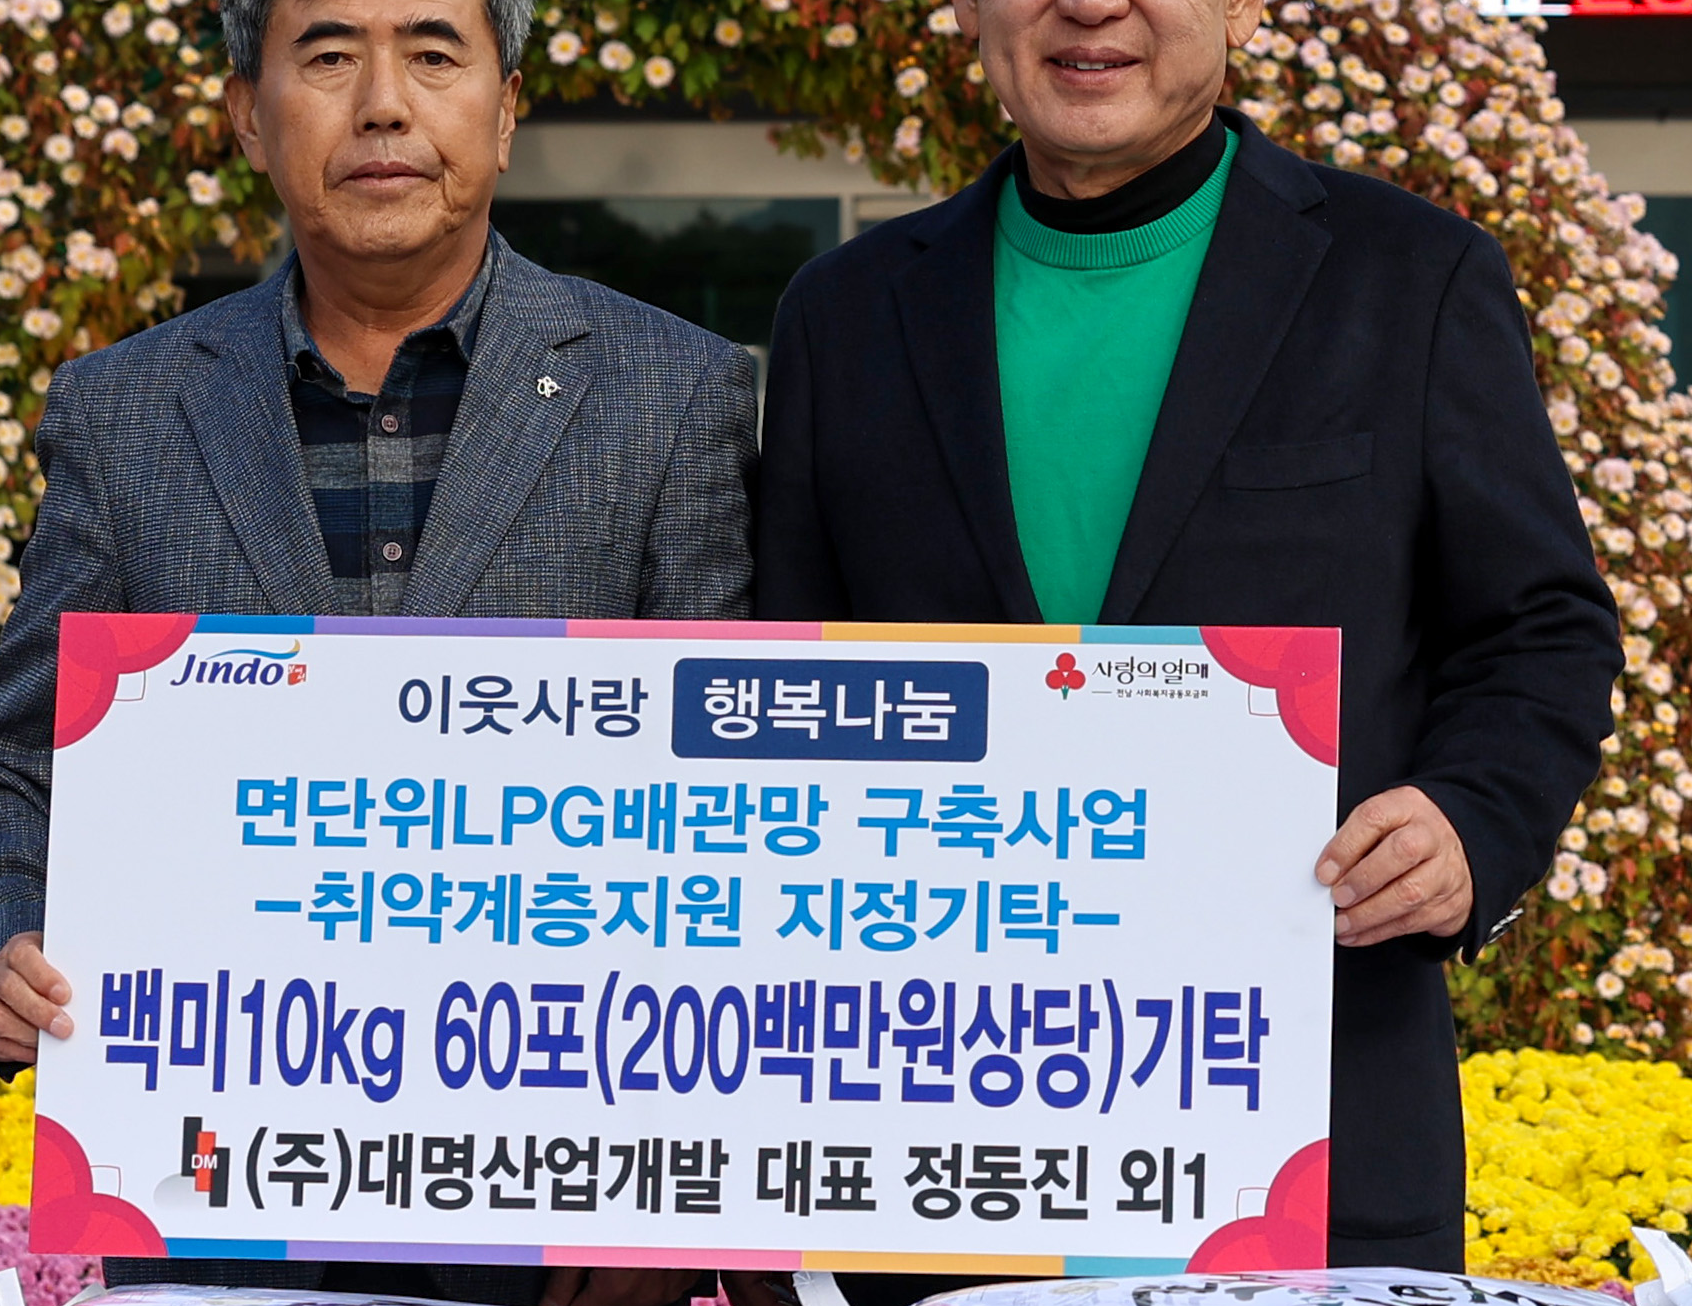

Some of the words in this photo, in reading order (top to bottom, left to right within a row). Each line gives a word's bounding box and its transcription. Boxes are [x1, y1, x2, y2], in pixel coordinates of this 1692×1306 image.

[170, 654, 284, 686] Jindo
[1092, 656, 1156, 685] 사랑의
[1163, 658, 1208, 685] 열매
[396, 674, 648, 737] 이웃사랑
[703, 677, 959, 743] 행복나눔
[232, 776, 825, 858] 면단위LPG배관망
[858, 784, 1149, 860] 구축사업
[255, 873, 743, 951] -취약계층지원
[776, 877, 1121, 955] 지정기탁-
[99, 967, 405, 1094] 백미10kg
[191, 1154, 218, 1169] DM
[244, 1127, 728, 1218] (주)대명산업개발
[755, 1134, 877, 1216] 대표
[907, 1141, 1089, 1221] 정동진
[1116, 1147, 1209, 1224] 외1
